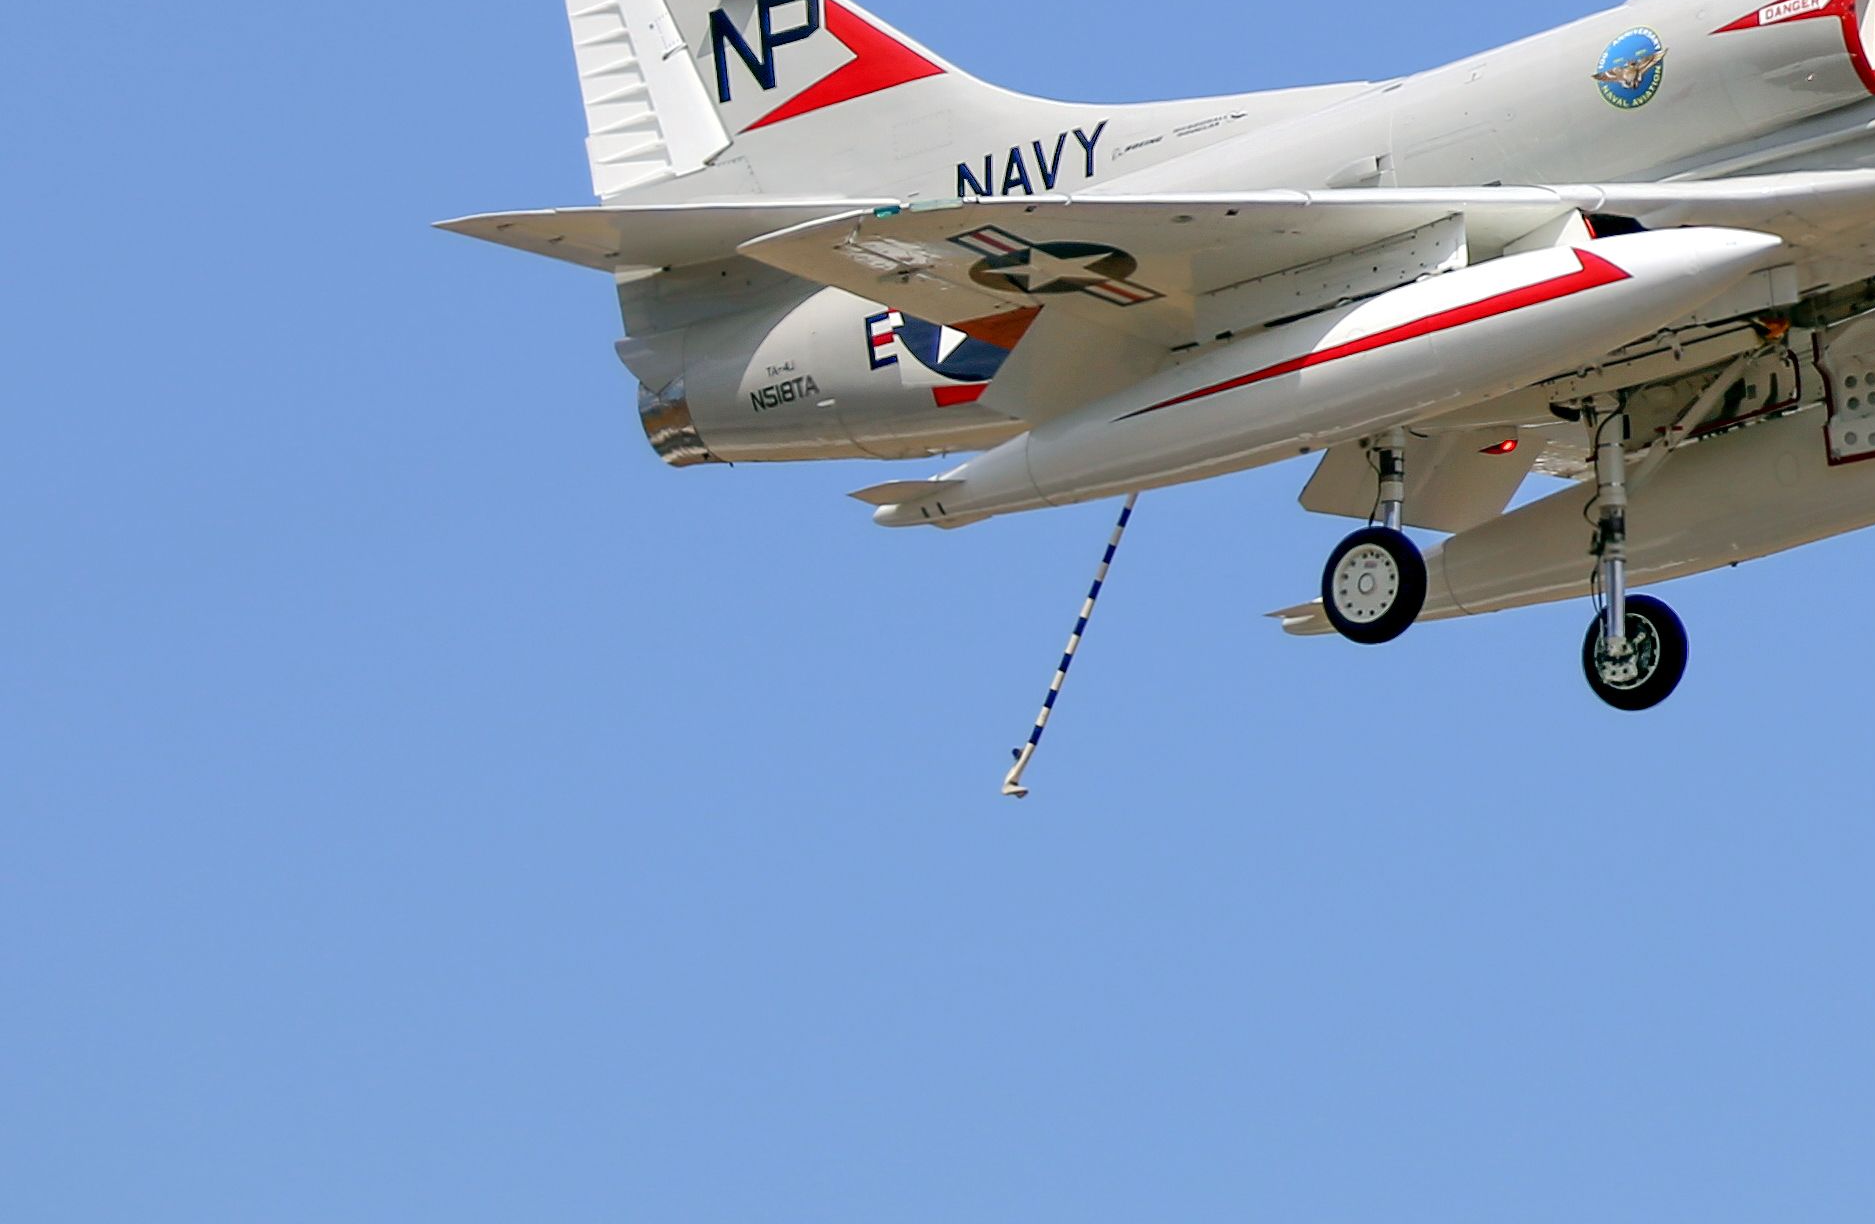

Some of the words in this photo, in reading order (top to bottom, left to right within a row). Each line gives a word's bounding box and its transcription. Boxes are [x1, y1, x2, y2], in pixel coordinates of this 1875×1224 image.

[1602, 85, 1629, 107] NAVAL
[1632, 65, 1661, 106] AVIATION
[957, 119, 1109, 197] NAVY
[750, 376, 820, 412] N518TA
